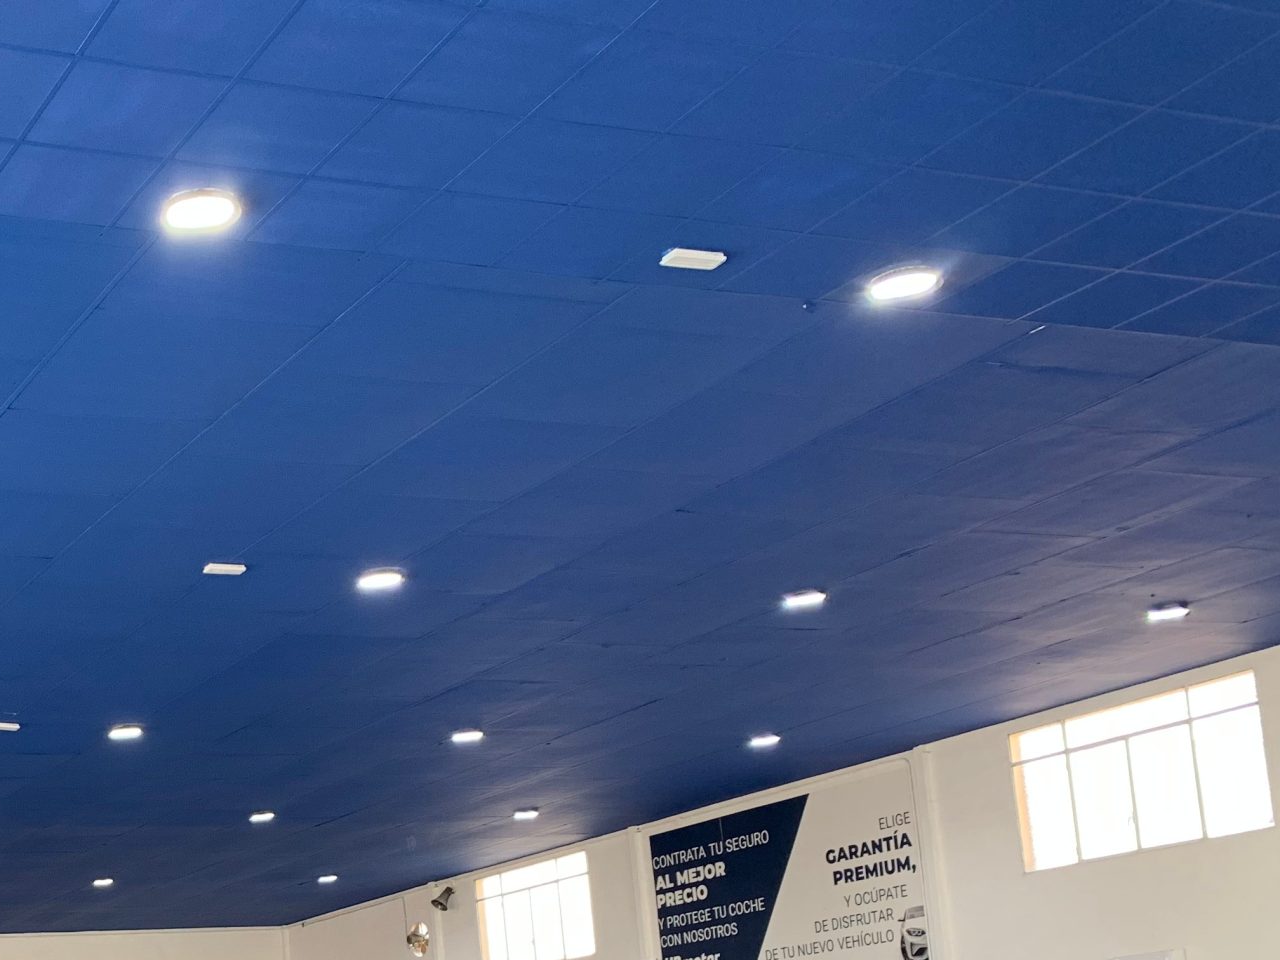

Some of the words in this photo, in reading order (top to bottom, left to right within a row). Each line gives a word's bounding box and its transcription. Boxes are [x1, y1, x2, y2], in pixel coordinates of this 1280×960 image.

[878, 811, 911, 830] ELIGE
[652, 845, 707, 870] CONTRATA
[708, 840, 724, 856] TU
[725, 829, 770, 853] SEGURO
[825, 829, 913, 865] GARANTÍA
[656, 873, 675, 891] AL
[675, 861, 726, 886] MEJOR
[832, 855, 917, 886] PREMIUM,
[656, 884, 709, 909] PRECIO
[843, 895, 852, 908] Y
[853, 884, 908, 907] OCÚPATE
[658, 917, 666, 930] Y
[666, 907, 712, 929] PROTEGE
[712, 904, 727, 920] TU
[728, 897, 766, 917] COCHE
[814, 919, 829, 934] DE
[831, 907, 895, 932] DISFRUTAR
[660, 934, 682, 949] CON
[683, 922, 739, 945] NOSOTROS
[780, 945, 795, 959] TU
[797, 939, 835, 954] NUEVO
[836, 928, 895, 951] VEHÍCULO
